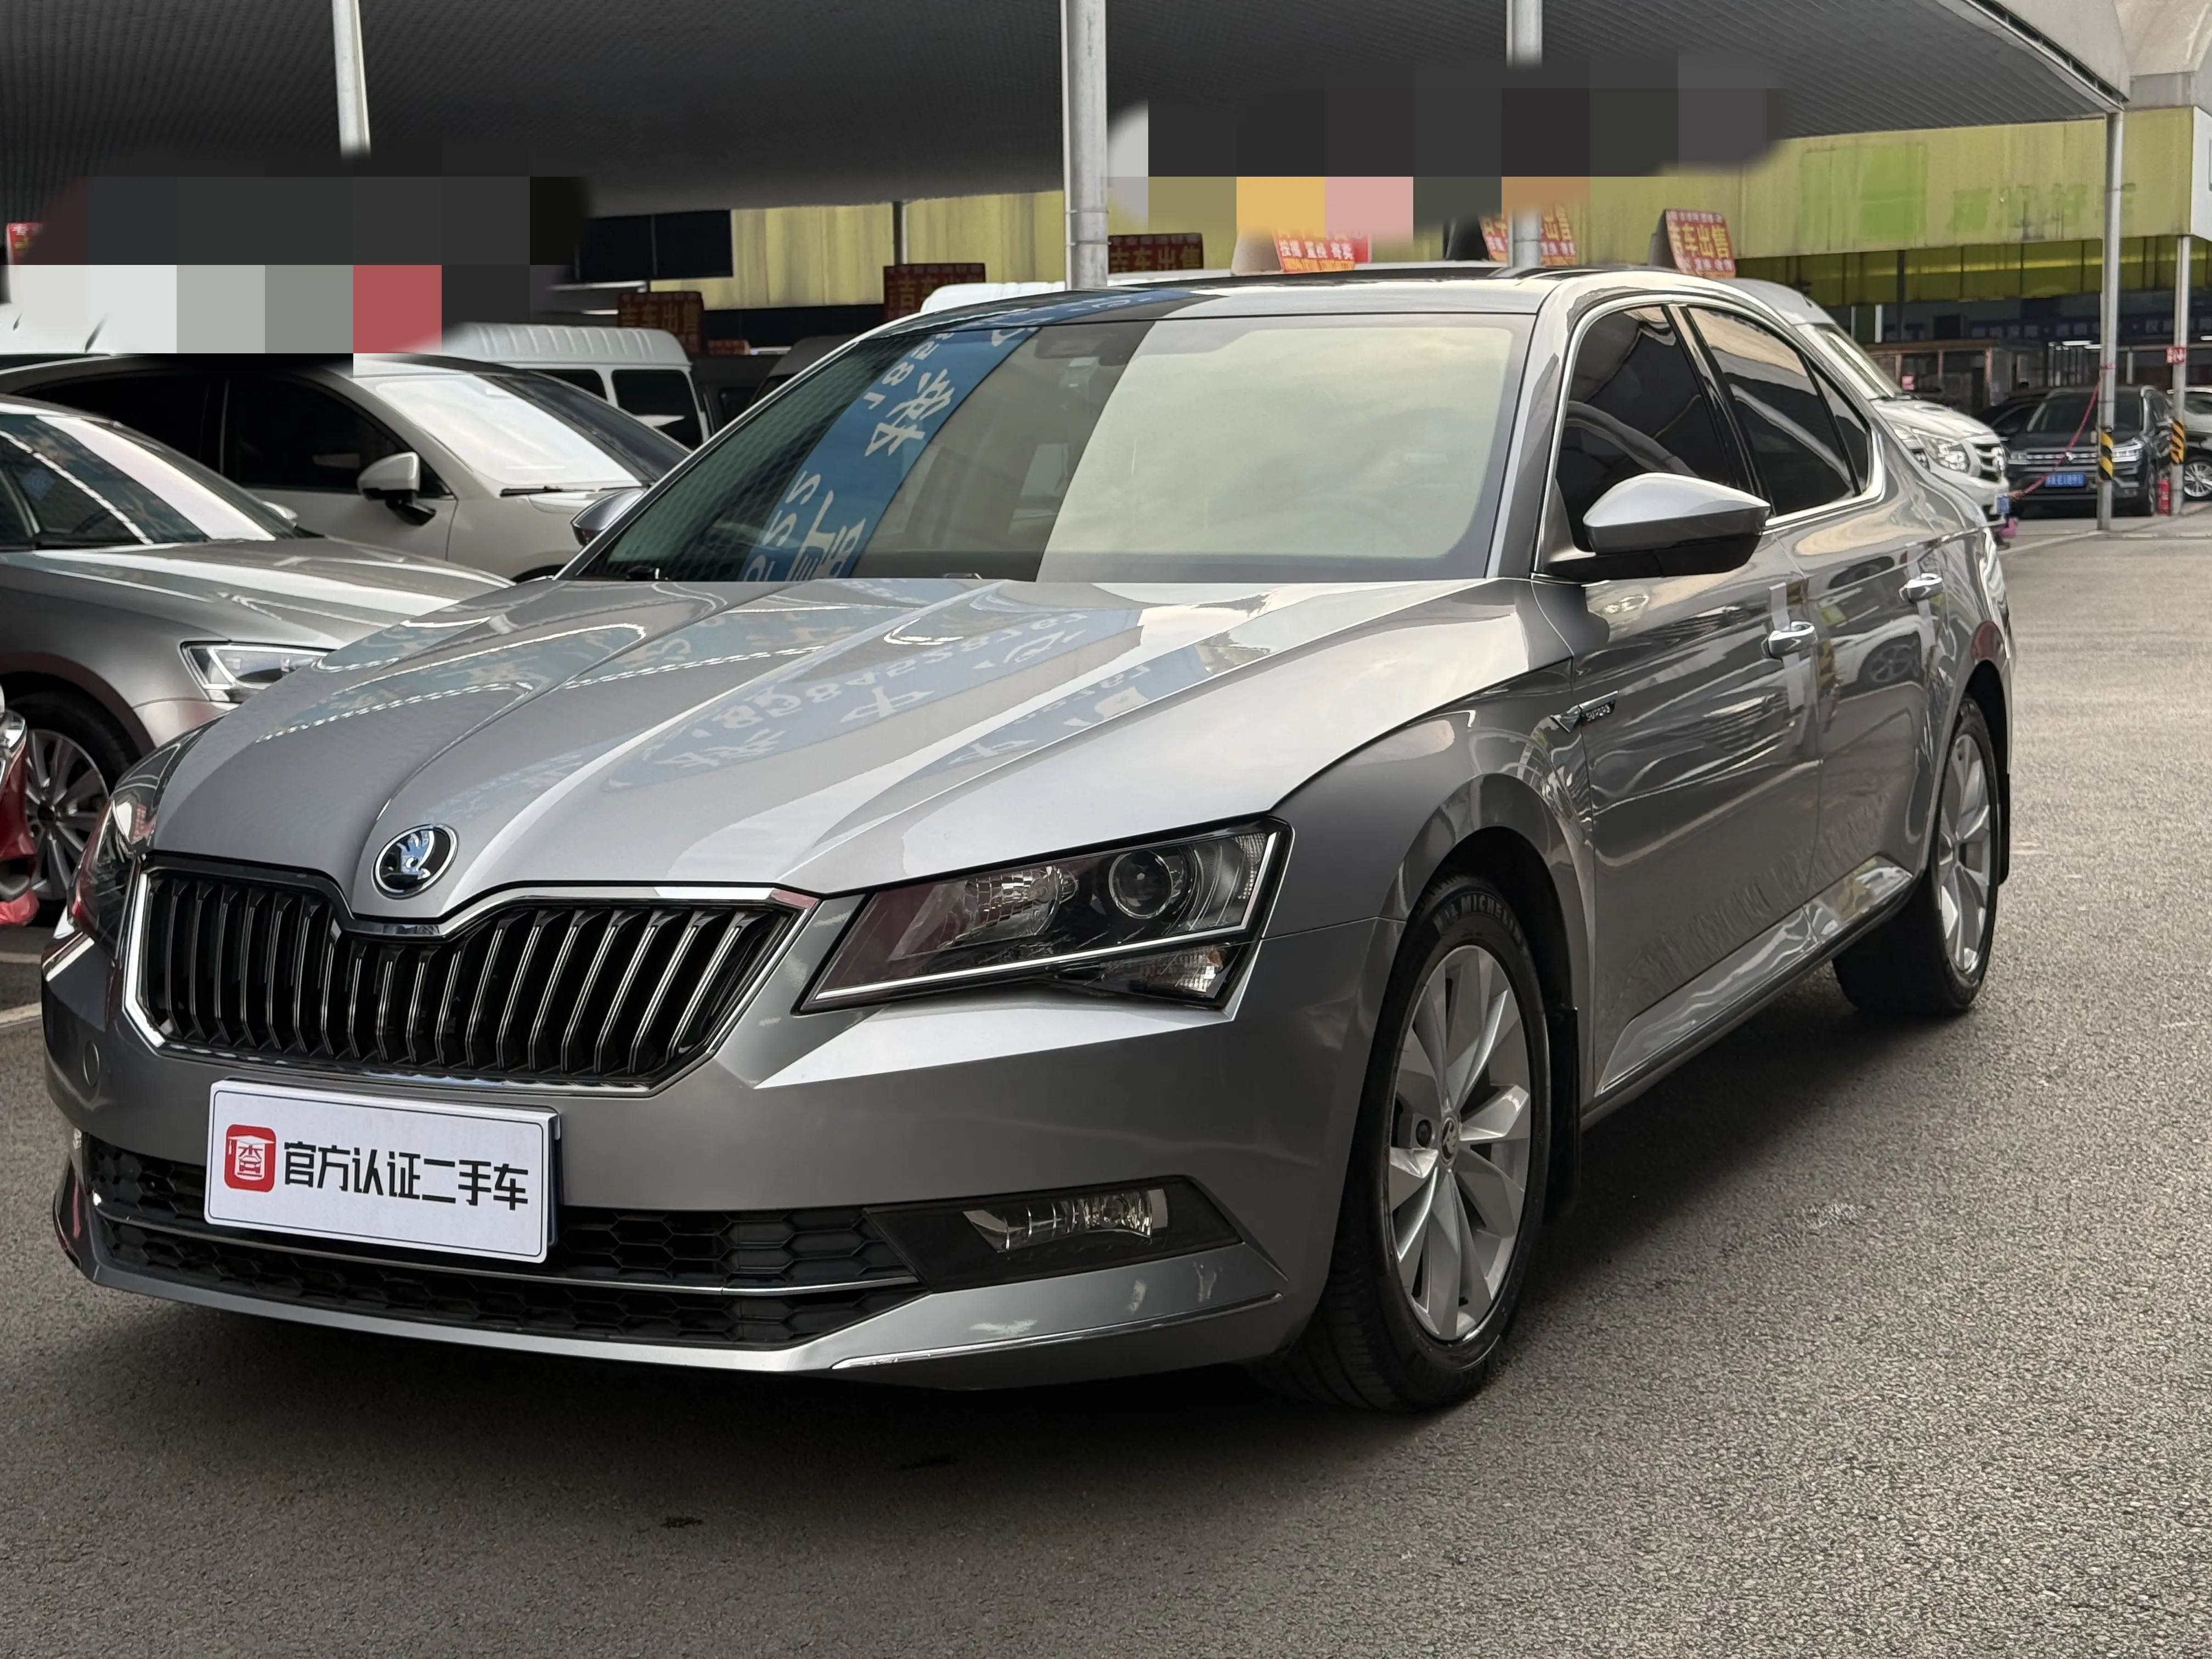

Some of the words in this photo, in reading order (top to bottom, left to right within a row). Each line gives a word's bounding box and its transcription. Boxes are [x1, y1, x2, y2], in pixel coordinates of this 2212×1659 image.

[1460, 893, 1522, 944] MICHELIN
[283, 1141, 529, 1211] 官方认证二手车
